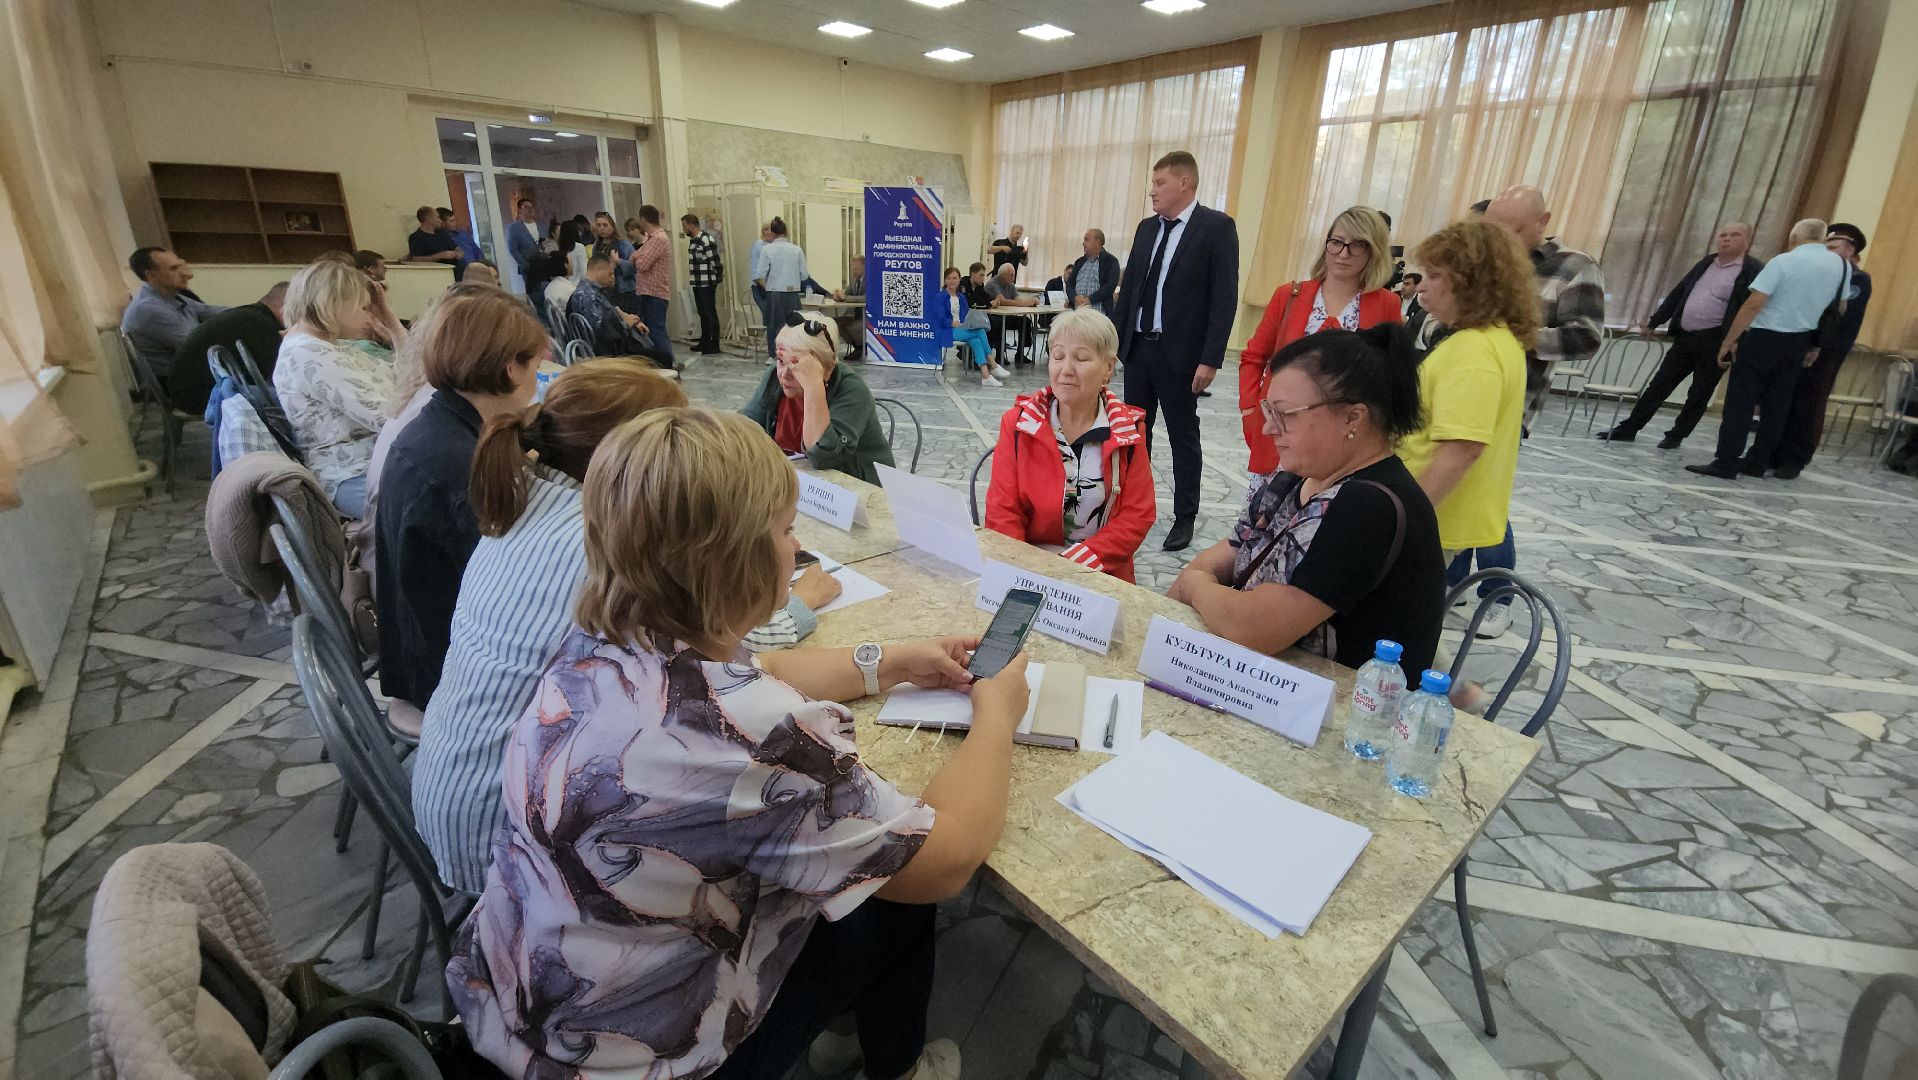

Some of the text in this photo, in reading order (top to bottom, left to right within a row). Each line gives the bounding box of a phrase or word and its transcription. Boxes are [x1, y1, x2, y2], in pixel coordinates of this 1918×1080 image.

[893, 221, 913, 229] Реутов
[884, 235, 922, 243] ВЫЕЗДНАЯ
[873, 243, 933, 251] АДМИНИСТРАЦИЯ
[873, 251, 911, 259] ГОРОДСКОГО
[885, 260, 922, 270] РЕУТОВ
[877, 320, 931, 330] НАМ ВАЖНО
[873, 328, 935, 339] ВАШЕ МНЕНИЕ
[1042, 617, 1070, 634] Оксана
[1071, 627, 1107, 647] Юрьевна
[1165, 633, 1300, 693] КУЛЬТУРА И СПОРТ
[1170, 656, 1279, 707] Николаенко Анастасия
[1185, 675, 1253, 711] Владимировна
